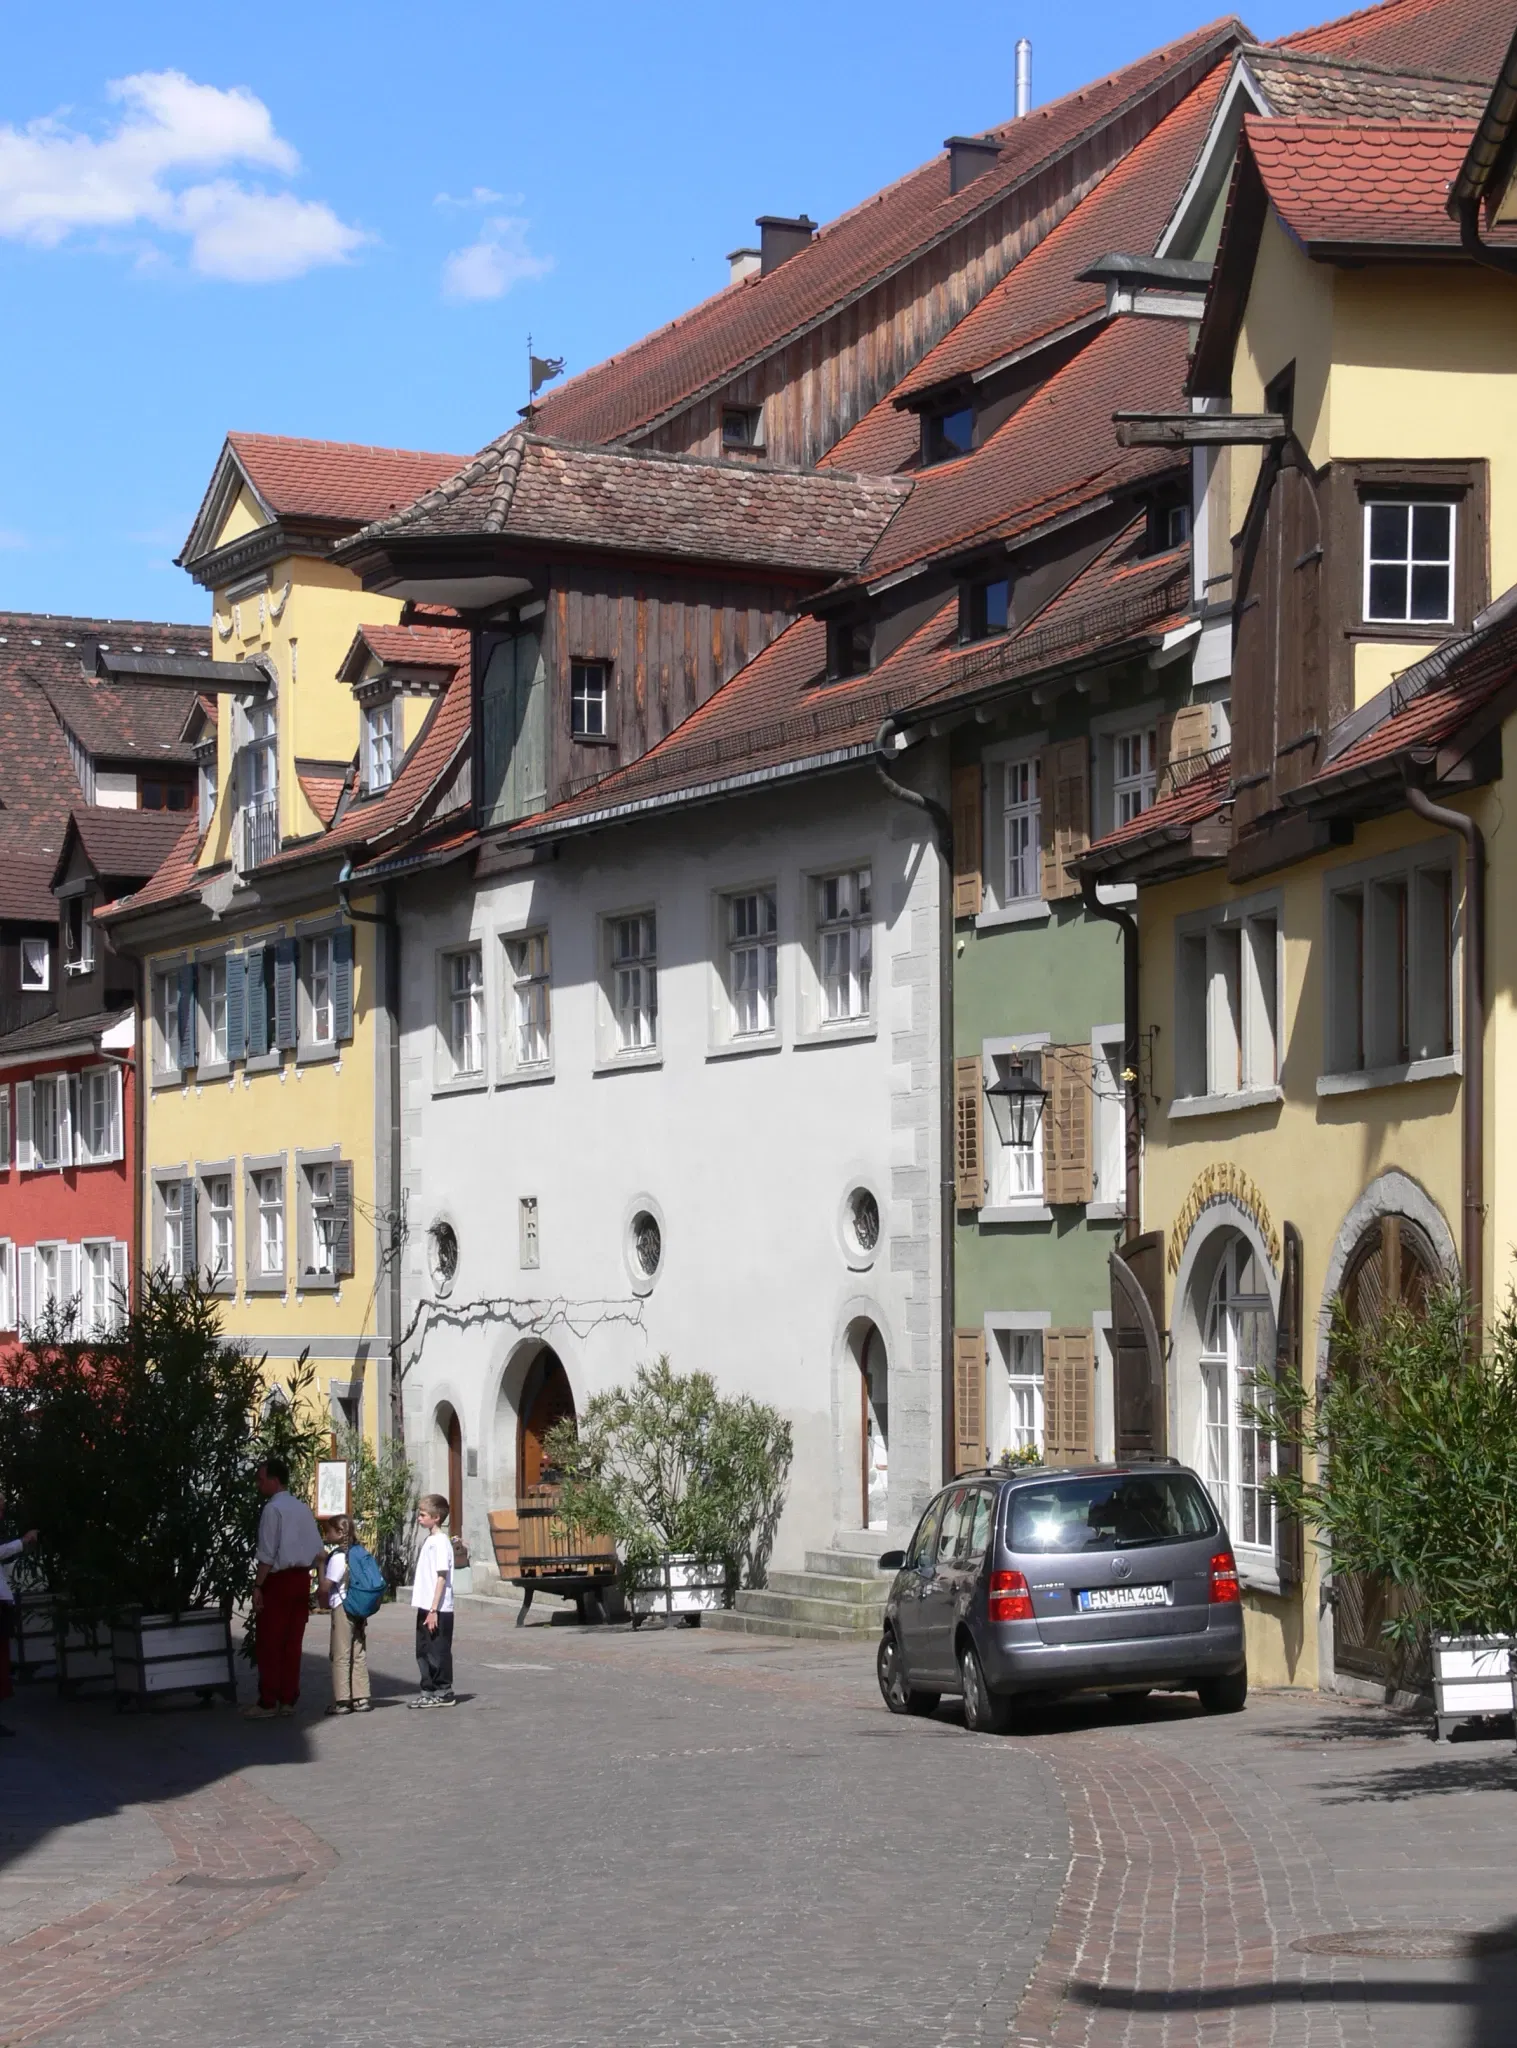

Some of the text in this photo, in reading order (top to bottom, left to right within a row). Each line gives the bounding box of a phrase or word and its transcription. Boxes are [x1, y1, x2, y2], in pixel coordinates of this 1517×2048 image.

[1090, 1590, 1108, 1606] FN
[1117, 1588, 1136, 1603] HA
[1138, 1586, 1163, 1601] 404
